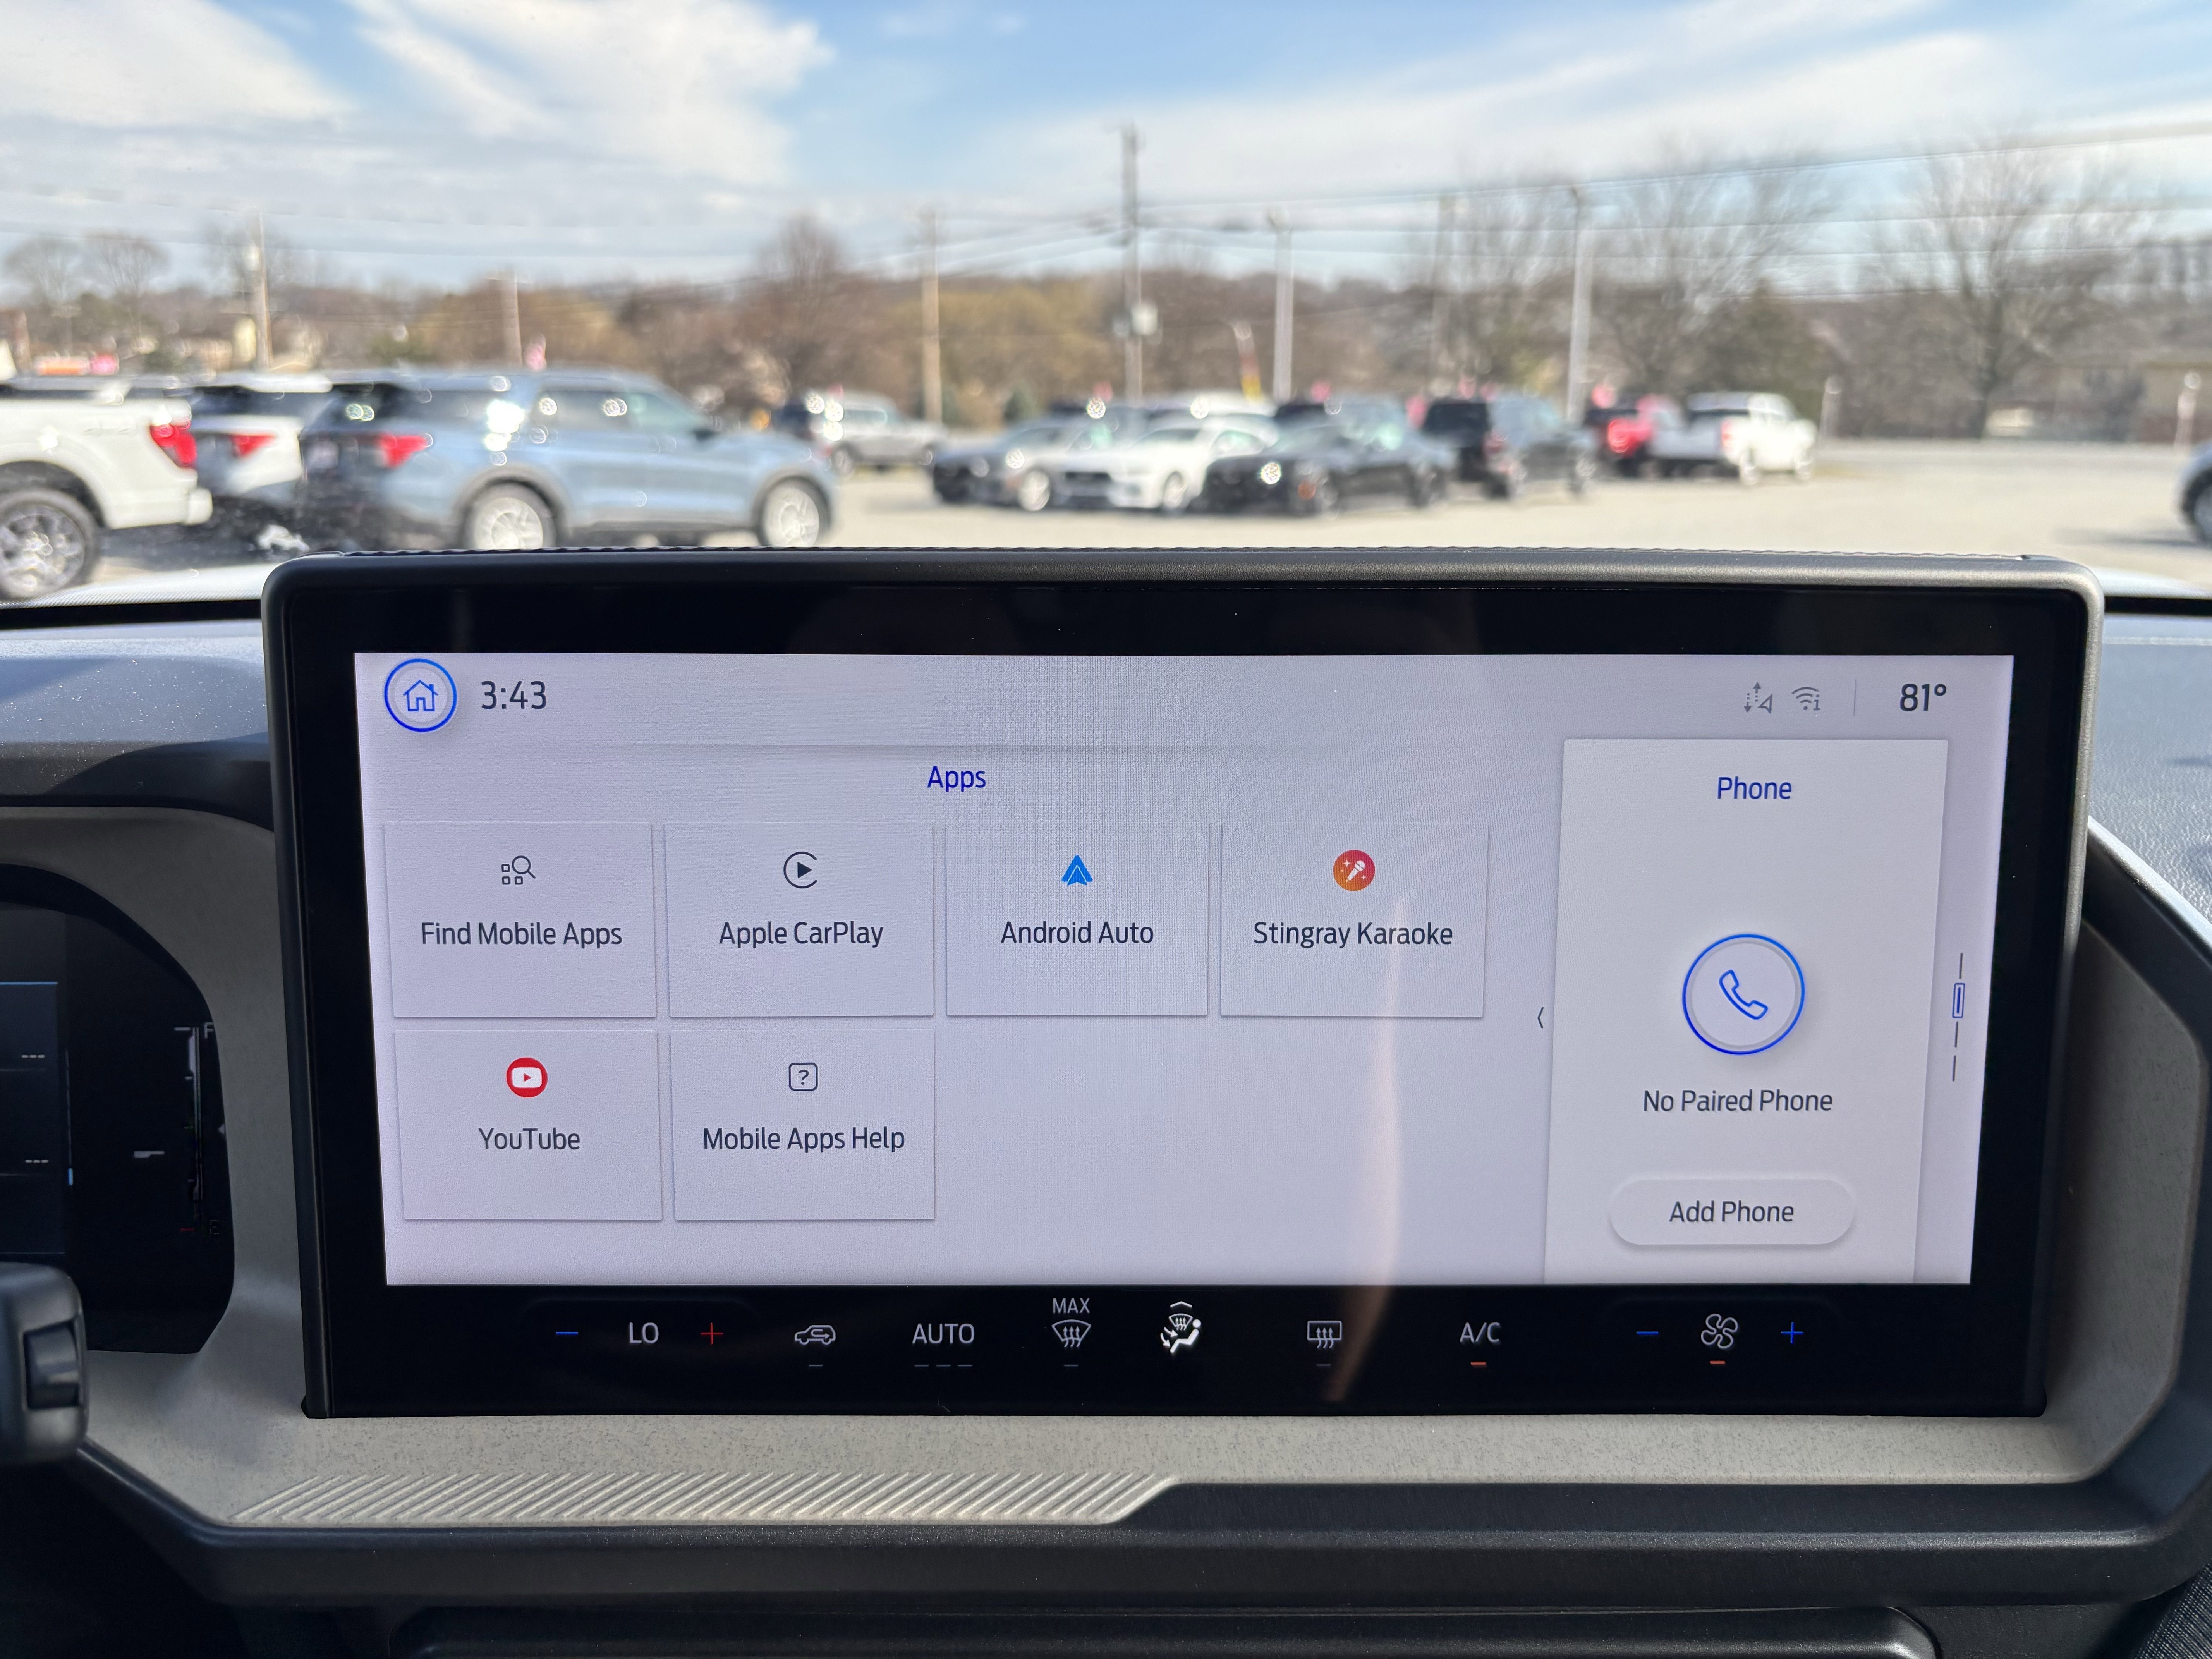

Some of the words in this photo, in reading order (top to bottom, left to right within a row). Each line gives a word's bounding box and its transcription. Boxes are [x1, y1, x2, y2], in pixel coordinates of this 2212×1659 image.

[481, 681, 546, 709] 3:43
[1900, 684, 1947, 712] 81°
[927, 765, 986, 792] Apps
[1717, 776, 1792, 799] Phone
[422, 921, 471, 945] Find
[478, 922, 556, 945] Mobile
[563, 922, 622, 949] Apps
[719, 921, 787, 948] Apple
[794, 921, 884, 948] CarPlay
[1001, 920, 1091, 943] Android
[1098, 921, 1154, 943] Auto
[1253, 922, 1351, 948] Stingray
[1358, 921, 1453, 945] Karaoke
[1644, 1090, 1674, 1112] No
[1681, 1089, 1753, 1111] Paired
[1760, 1089, 1832, 1111] Phone
[478, 1127, 580, 1150] YouTube
[704, 1127, 780, 1150] Mobile
[787, 1127, 845, 1153] Apps
[852, 1126, 905, 1152] Help
[1669, 1200, 1714, 1222] Add
[1721, 1200, 1794, 1222] Phone
[1053, 1297, 1090, 1314] MAX
[629, 1322, 659, 1343] LO
[912, 1323, 975, 1344] AUTO
[1459, 1322, 1501, 1343] A/C
